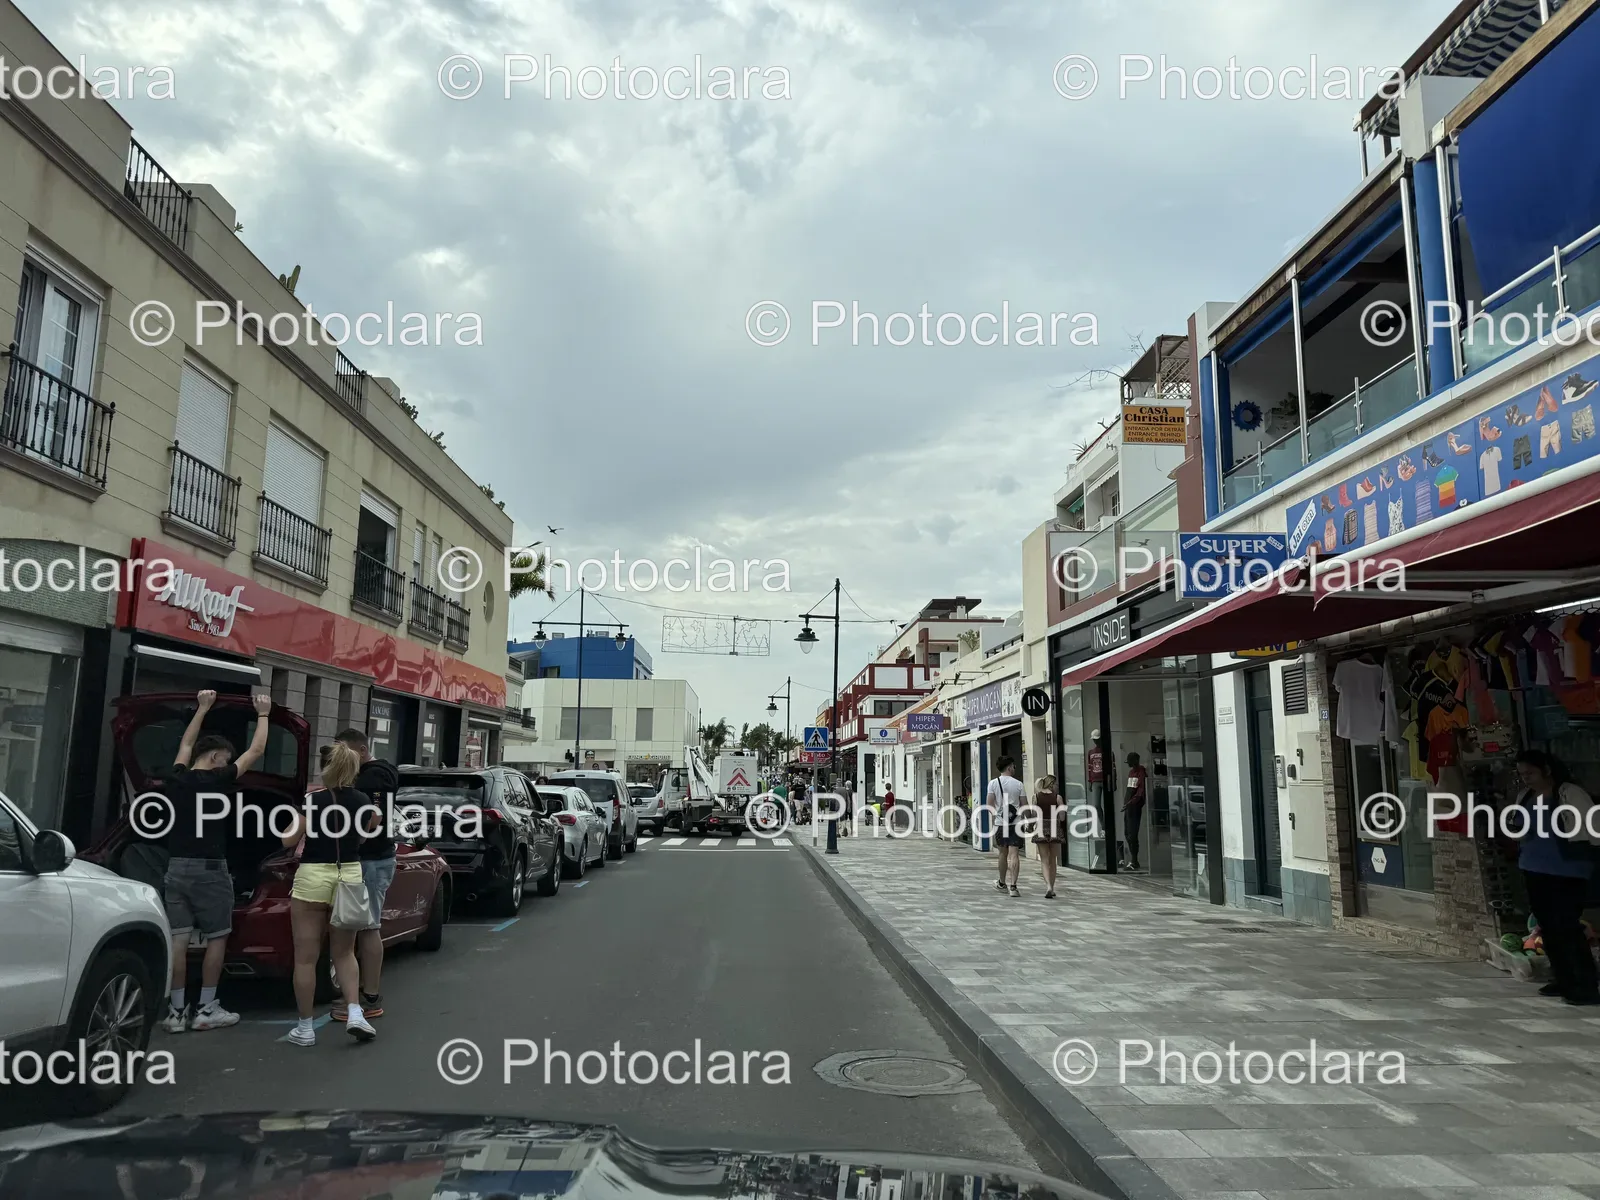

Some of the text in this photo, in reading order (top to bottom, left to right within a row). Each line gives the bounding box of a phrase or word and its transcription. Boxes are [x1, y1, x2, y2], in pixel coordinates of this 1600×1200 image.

[1124, 413, 1185, 423] Christian
[1139, 407, 1169, 415] CASA
[1199, 539, 1268, 554] SUPER
[188, 618, 204, 632] Since
[1093, 615, 1127, 649] INSIDE
[1027, 695, 1044, 710] IN
[911, 722, 940, 730] MOGÁN
